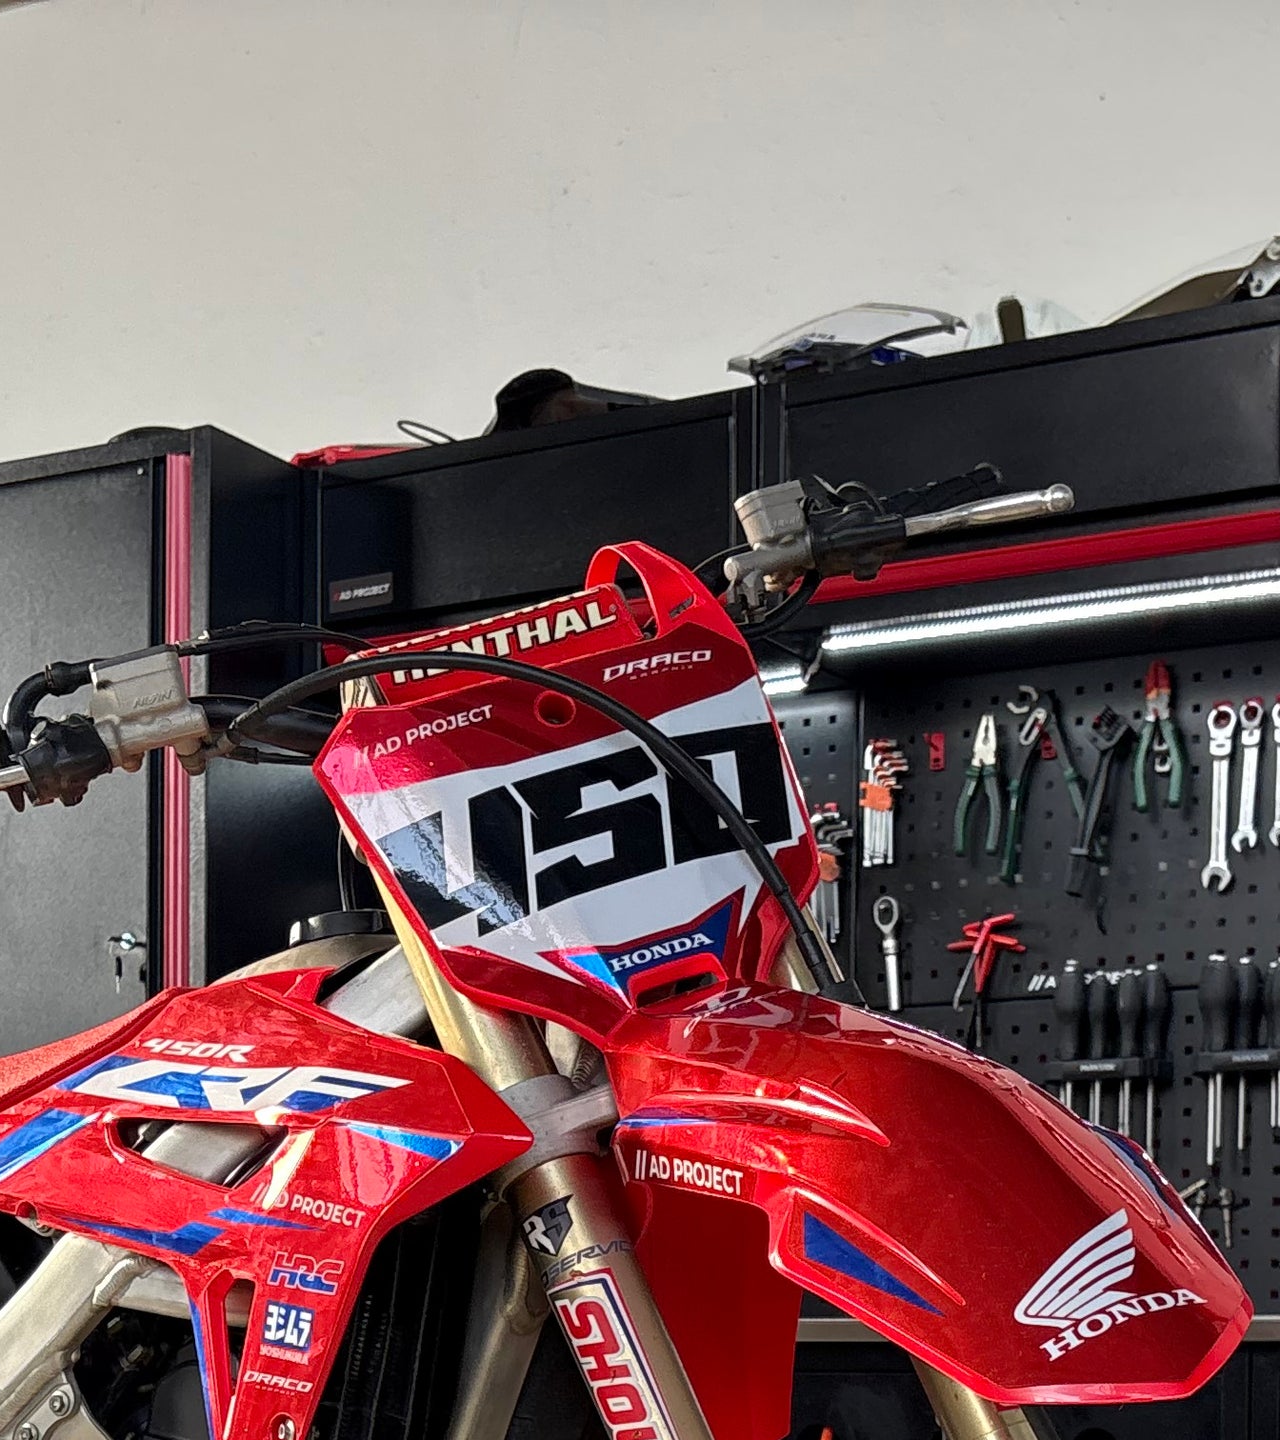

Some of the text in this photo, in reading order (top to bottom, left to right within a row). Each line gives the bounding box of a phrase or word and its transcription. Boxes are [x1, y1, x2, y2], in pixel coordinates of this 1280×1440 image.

[602, 649, 713, 684] DRACO
[405, 704, 494, 746] PROJECT
[609, 932, 715, 972] HONDA
[142, 1037, 256, 1063] 450R
[66, 1058, 415, 1112] CRF
[673, 1157, 744, 1196] PROJECT
[290, 1193, 367, 1230] PROJECT
[266, 1250, 345, 1297] HRC
[1039, 1287, 1209, 1362] HONDA
[243, 1370, 314, 1393] DRACO
